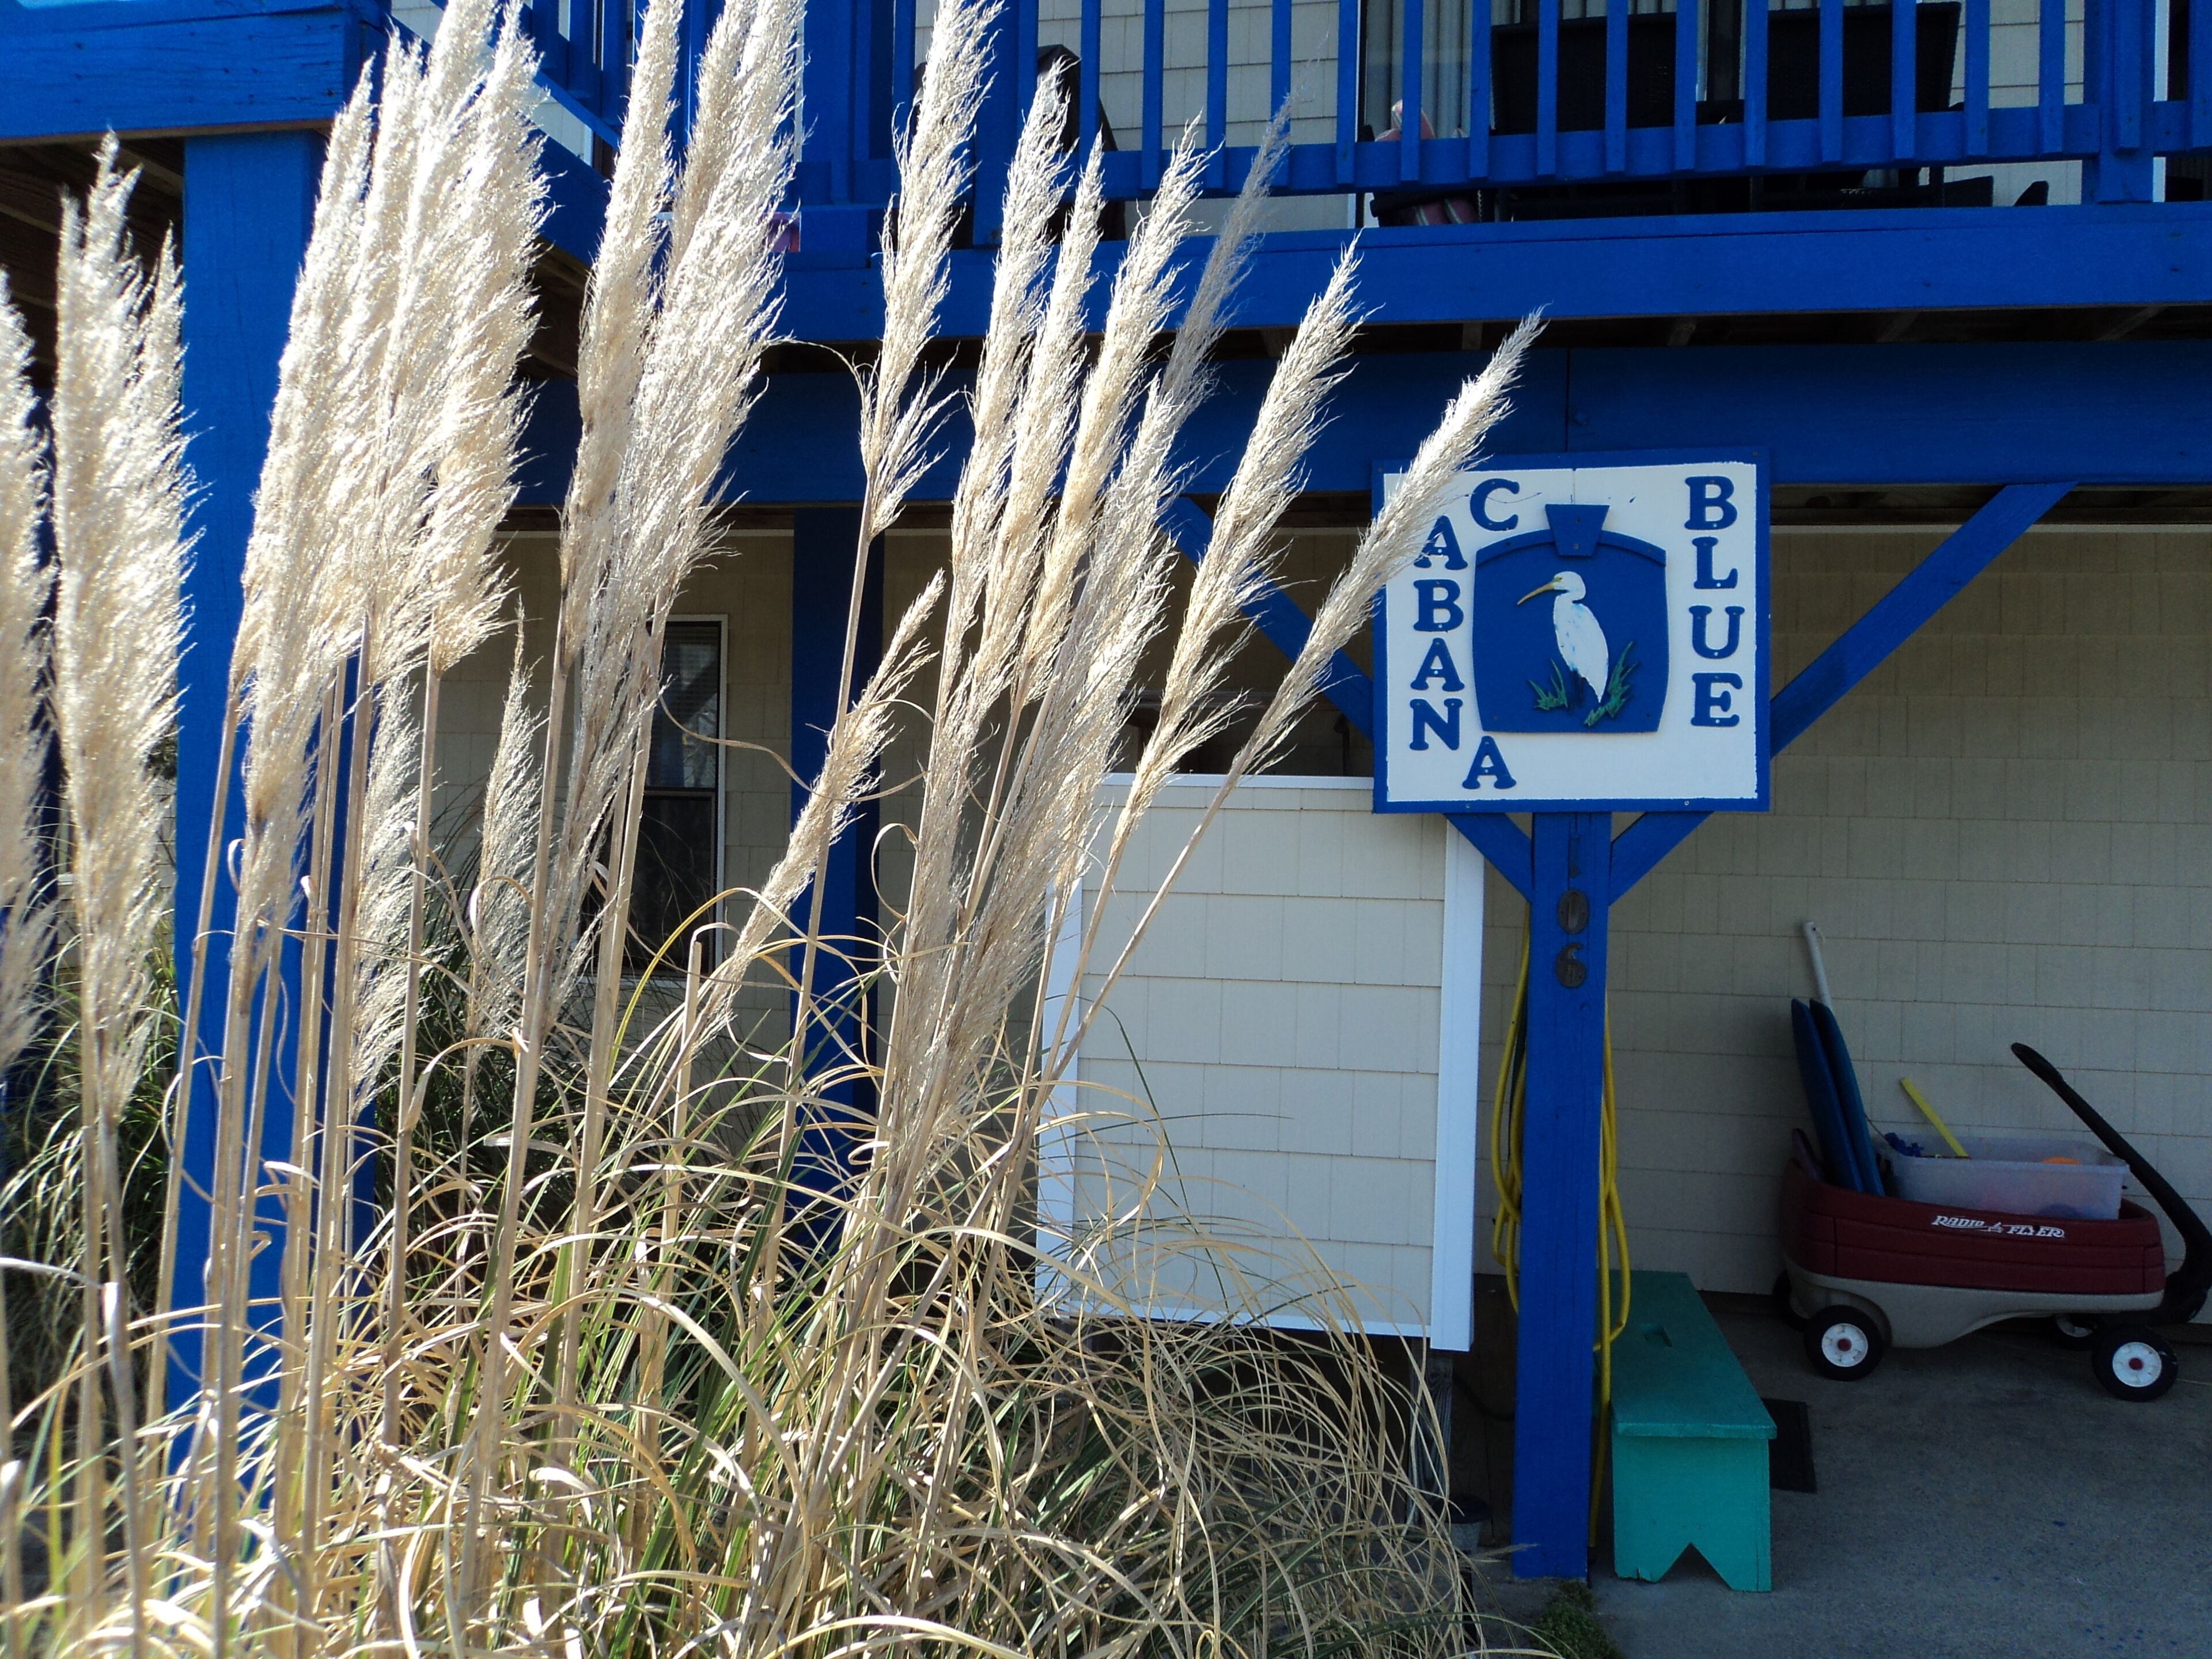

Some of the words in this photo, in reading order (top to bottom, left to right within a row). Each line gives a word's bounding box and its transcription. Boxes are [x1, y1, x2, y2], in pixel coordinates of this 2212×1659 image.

[1409, 478, 1520, 789] CABANA
[1684, 476, 1745, 728] BLUE
[1931, 1215, 1986, 1228] RADIO
[2006, 1225, 2065, 1238] FLYER
